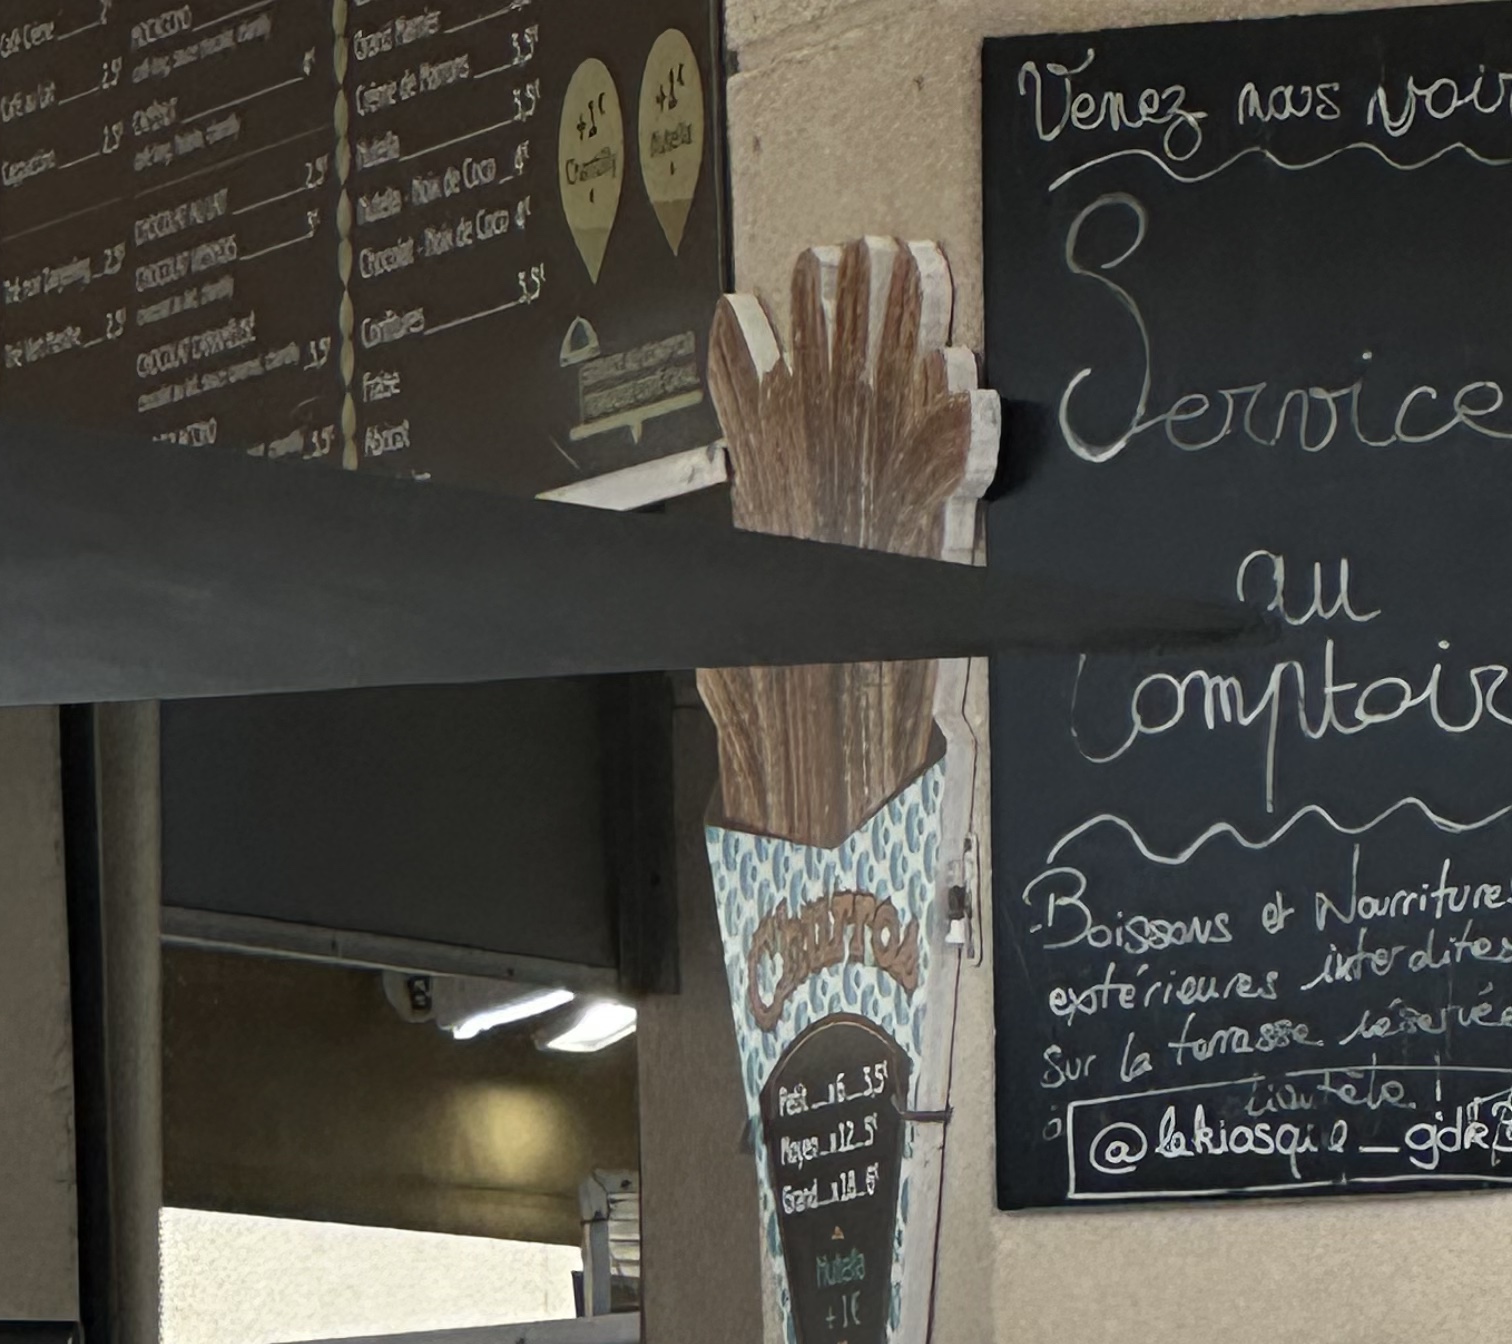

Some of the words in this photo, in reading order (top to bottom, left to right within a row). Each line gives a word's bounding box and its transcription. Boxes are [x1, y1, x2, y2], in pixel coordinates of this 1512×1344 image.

[1018, 48, 1208, 161] Venez
[1059, 191, 1512, 463] Service
[1237, 549, 1382, 626] au
[1023, 866, 1232, 952] Boissons
[1261, 890, 1295, 934] et
[1120, 1031, 1153, 1082] la
